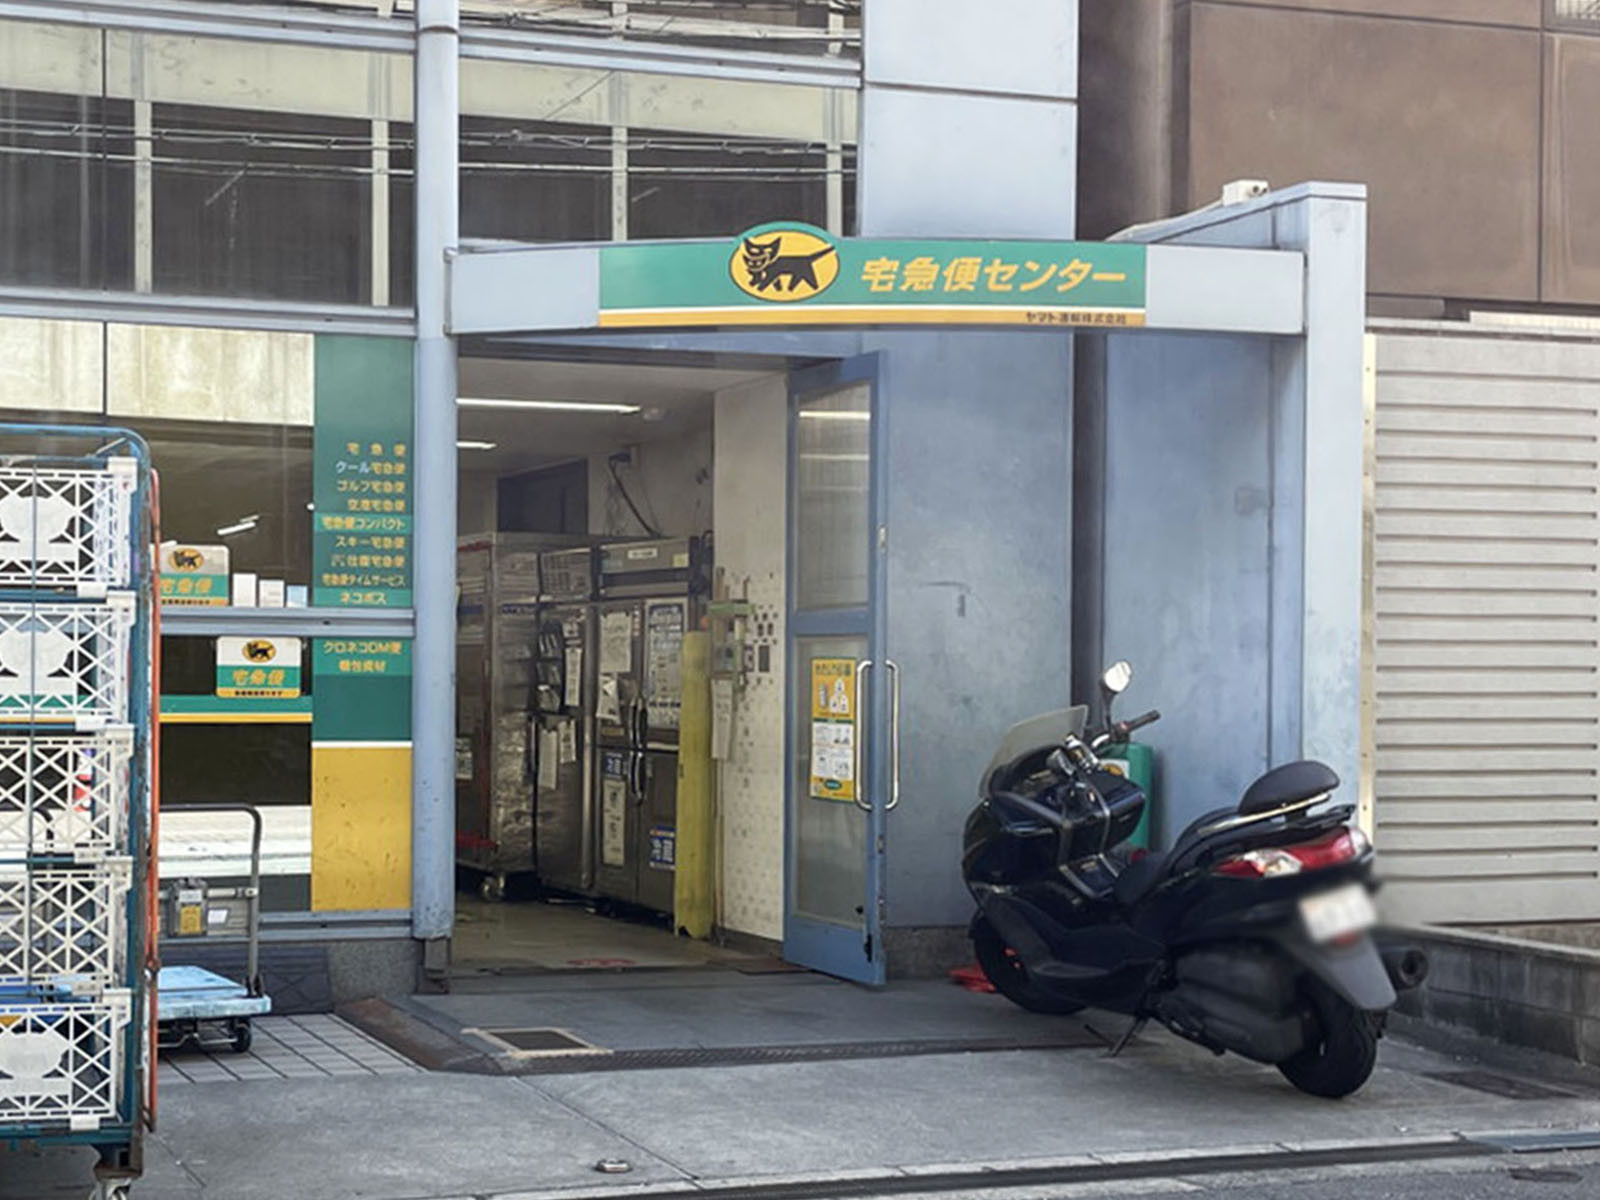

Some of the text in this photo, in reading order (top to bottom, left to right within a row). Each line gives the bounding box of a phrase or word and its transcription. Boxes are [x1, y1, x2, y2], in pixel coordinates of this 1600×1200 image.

[861, 257, 1126, 292] 宅急便センター
[1026, 311, 1126, 325] ヤマト運輸株式会社
